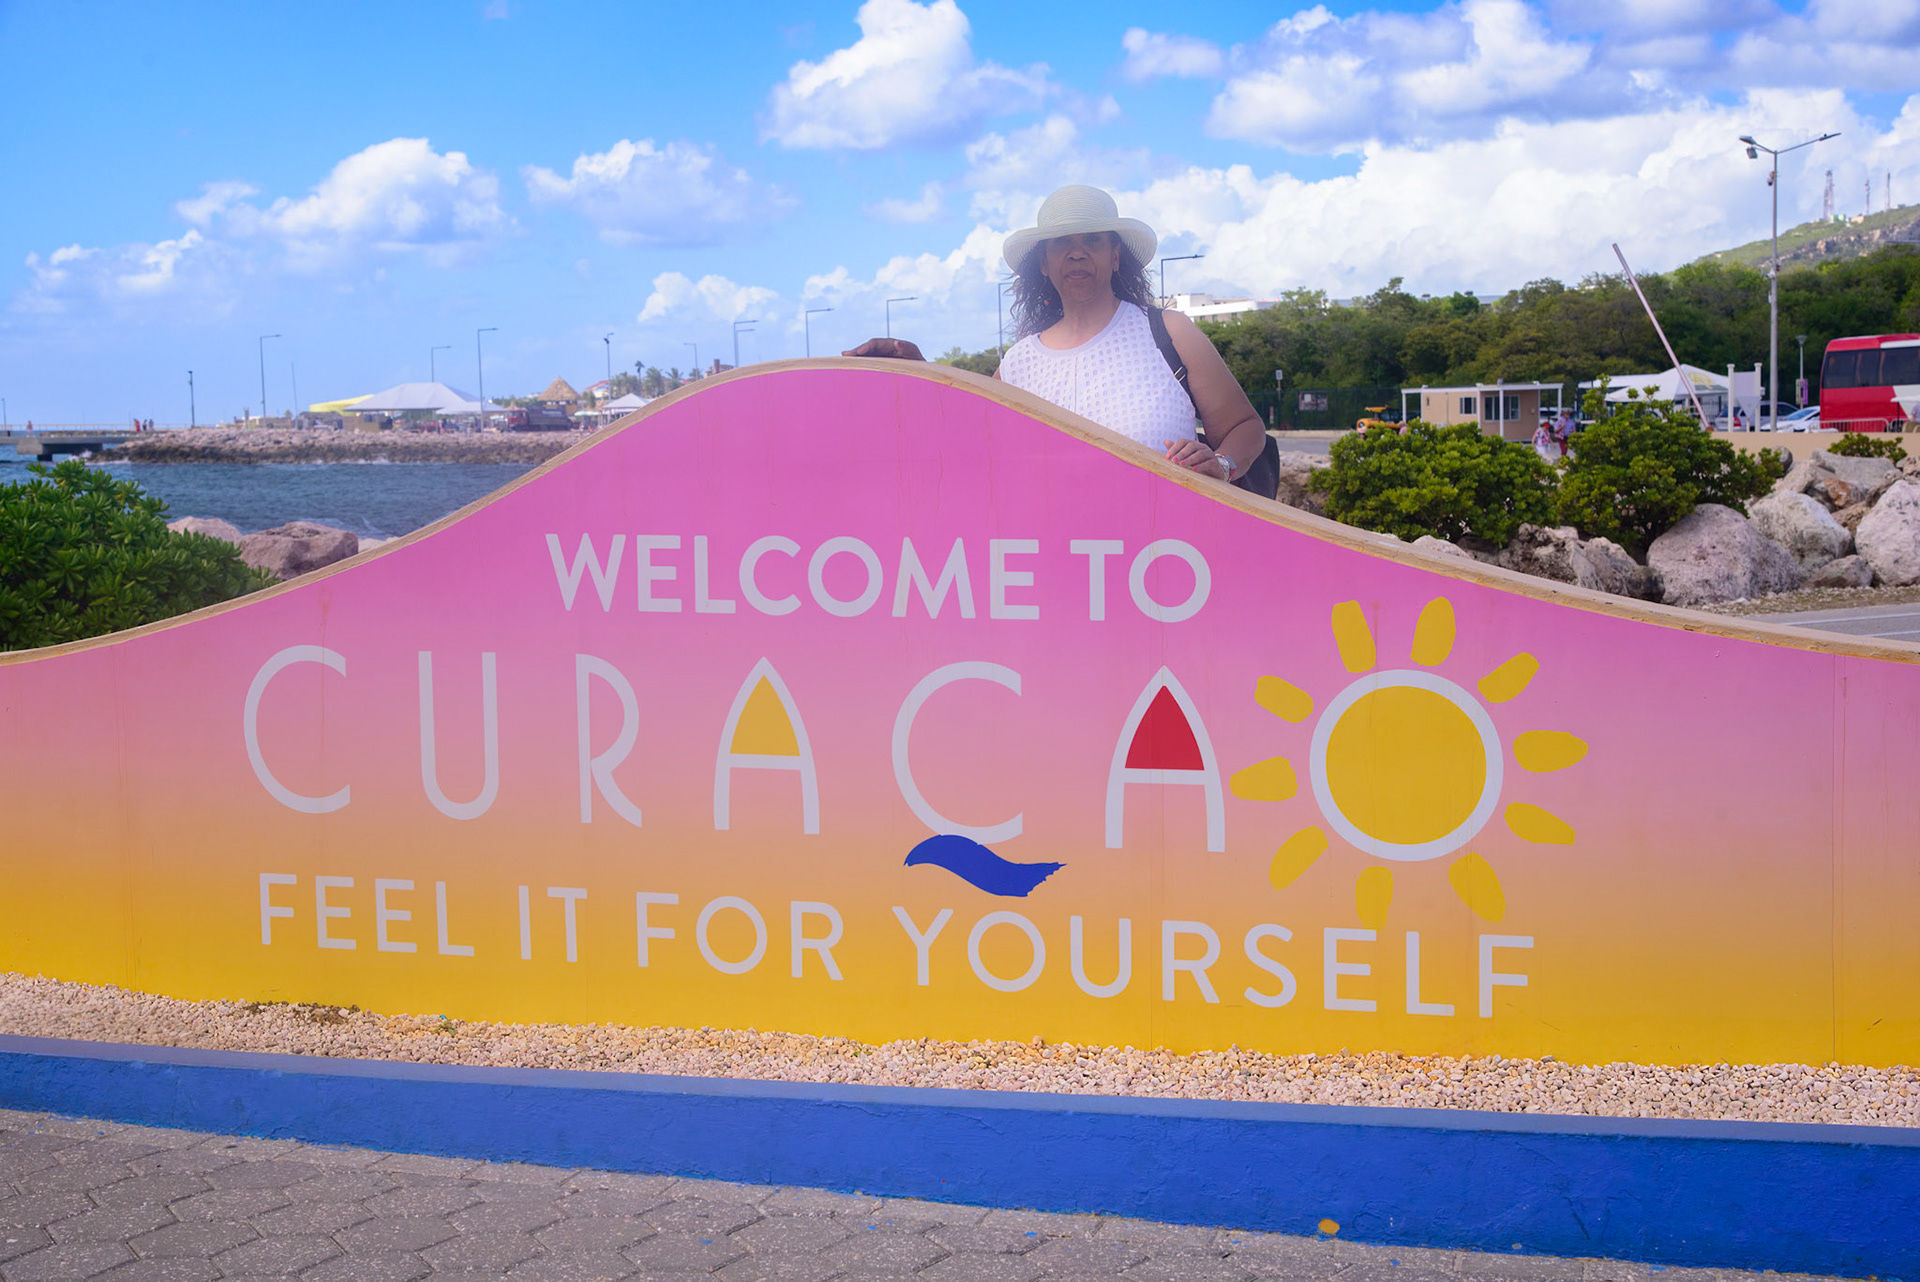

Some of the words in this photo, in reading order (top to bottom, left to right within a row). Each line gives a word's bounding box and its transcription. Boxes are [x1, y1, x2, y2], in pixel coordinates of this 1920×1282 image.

[545, 533, 1039, 619] WELCOME
[1070, 538, 1212, 623] TO
[243, 645, 1504, 897] CURAÇAO
[259, 872, 474, 956] FEEL
[518, 885, 587, 962] IT
[636, 891, 843, 980] FOR
[891, 906, 1534, 1019] YOURSELF
